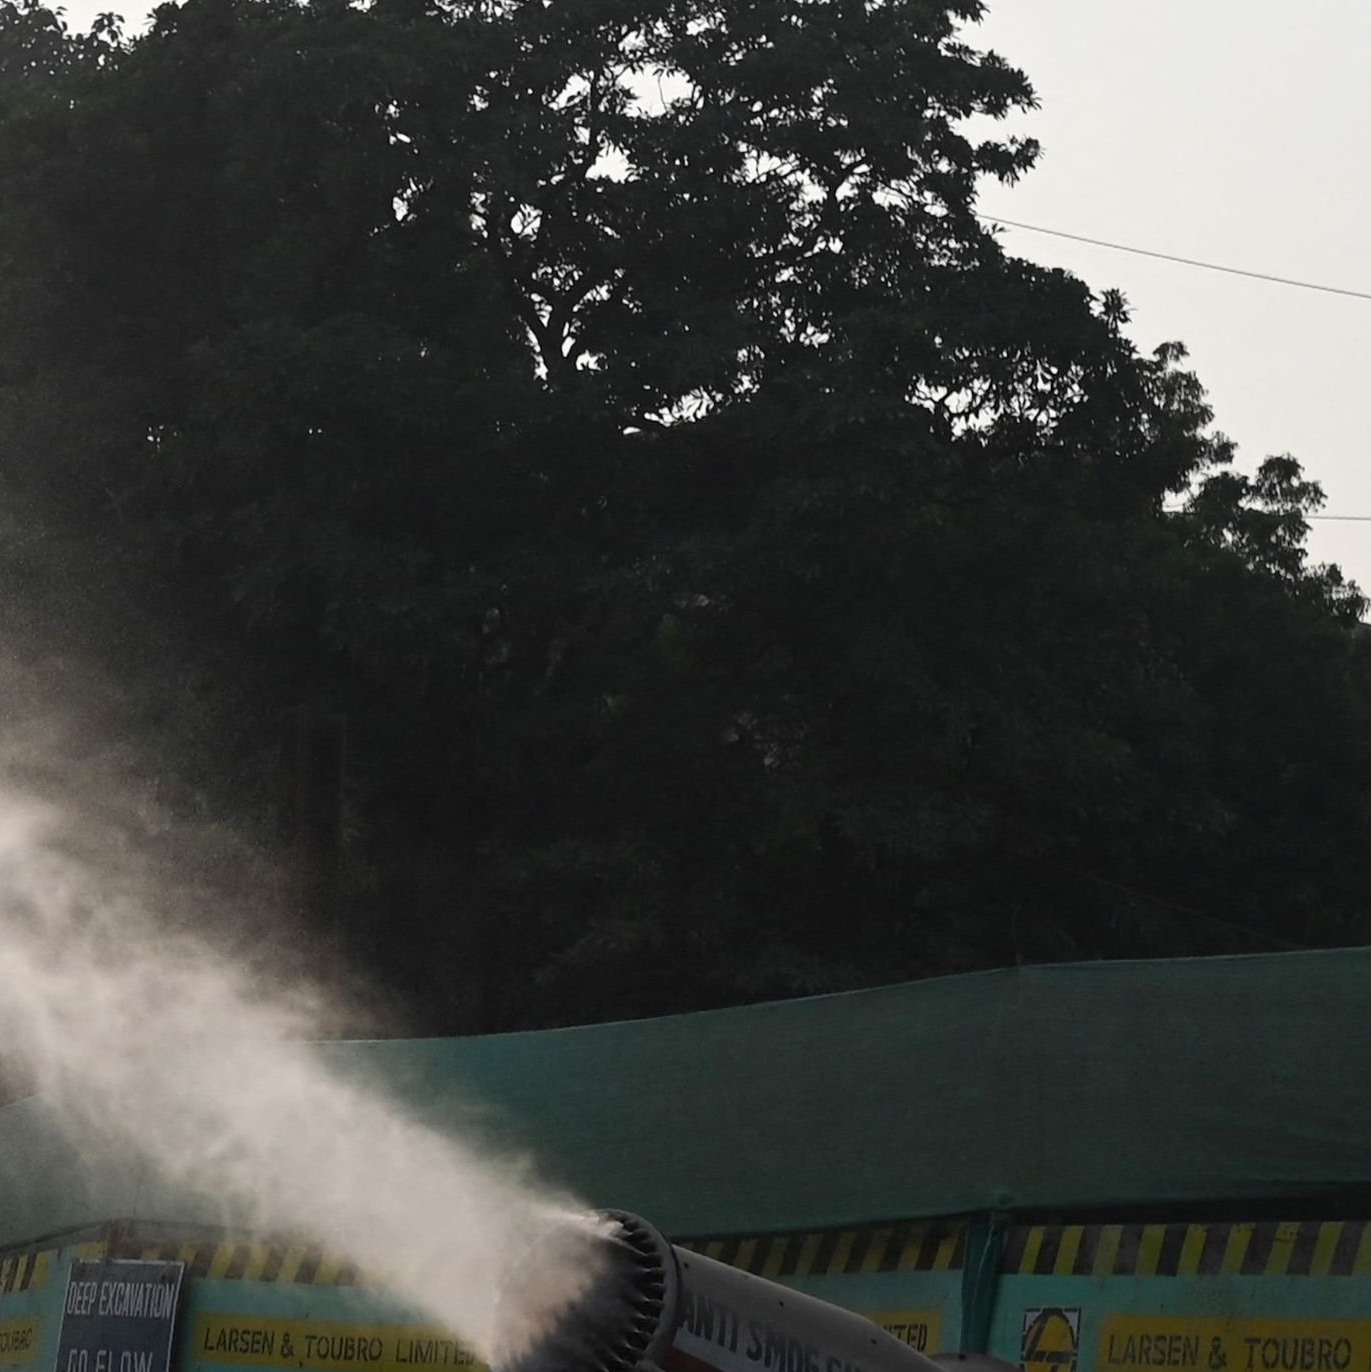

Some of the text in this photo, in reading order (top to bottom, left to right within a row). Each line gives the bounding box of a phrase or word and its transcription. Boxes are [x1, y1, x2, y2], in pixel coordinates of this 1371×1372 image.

[66, 1281, 175, 1320] DEEP EXCAVATION
[681, 1296, 738, 1353] ANTI
[203, 1327, 276, 1357] LARSEN
[280, 1332, 296, 1359] &
[304, 1334, 384, 1362] TOUBRO
[1106, 1334, 1353, 1371] LARSEN & TOUBRO
